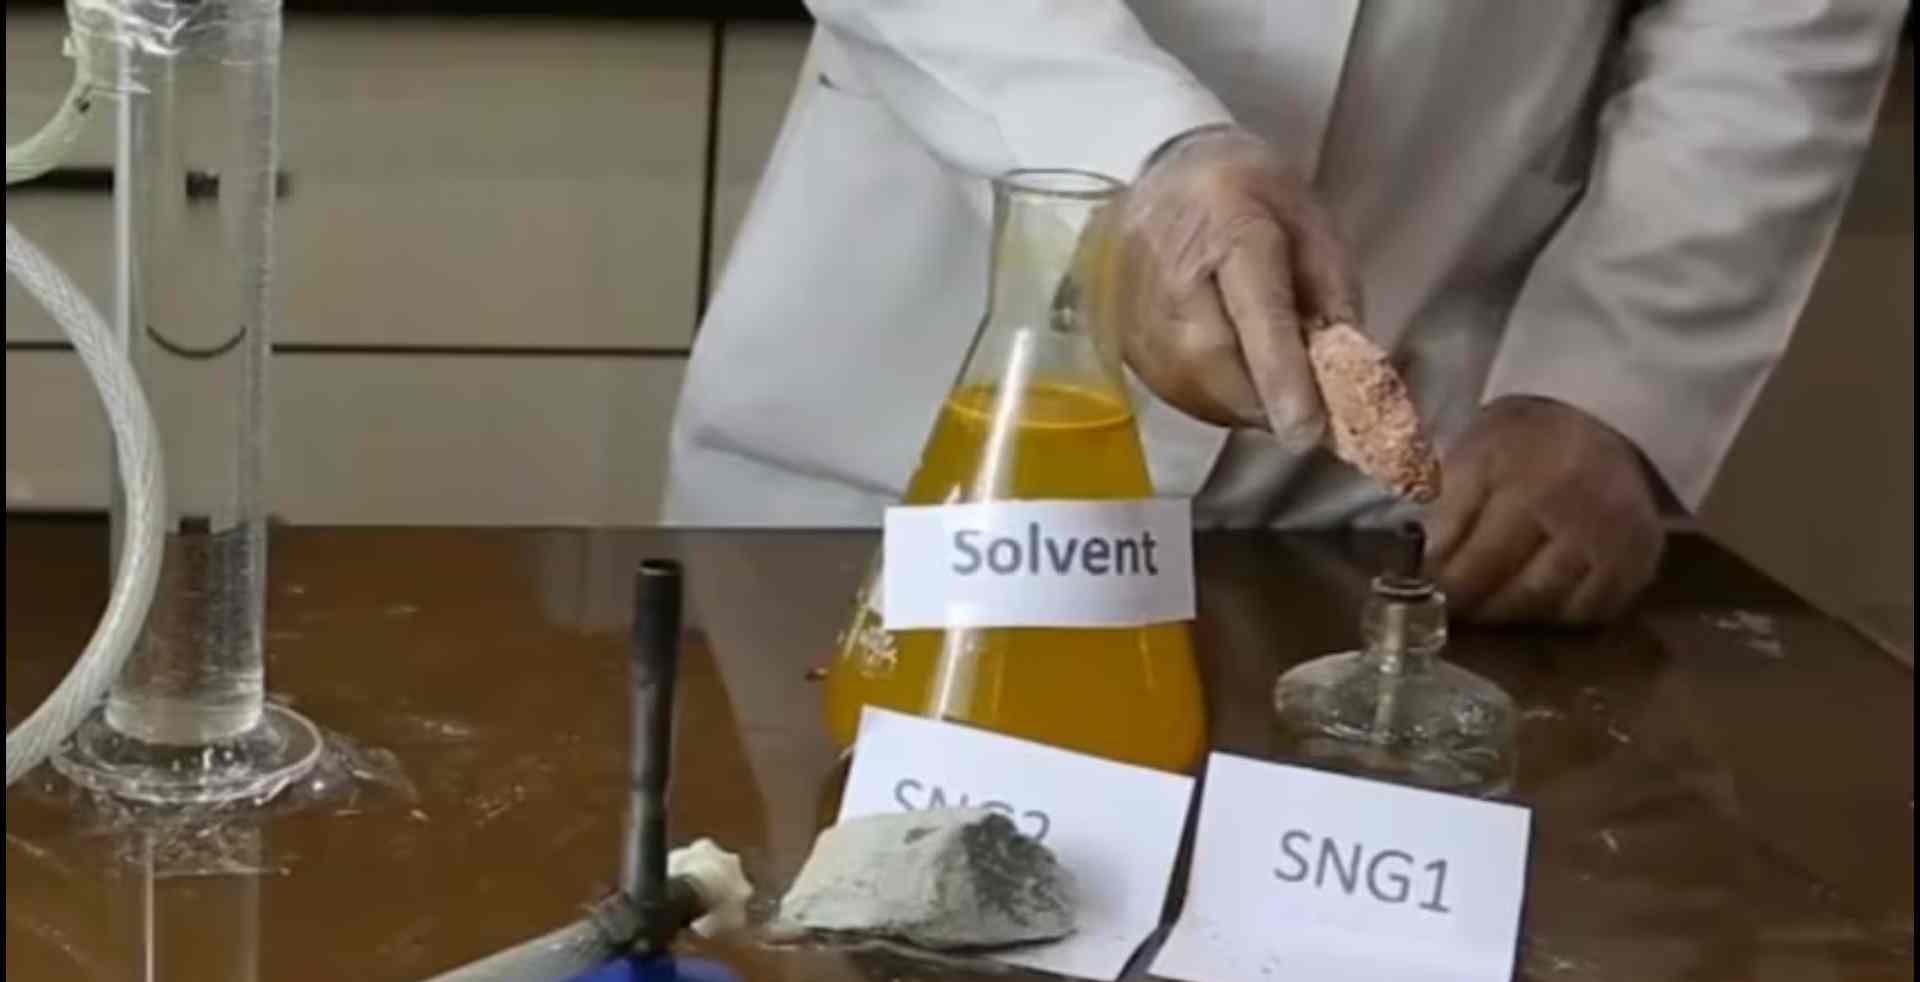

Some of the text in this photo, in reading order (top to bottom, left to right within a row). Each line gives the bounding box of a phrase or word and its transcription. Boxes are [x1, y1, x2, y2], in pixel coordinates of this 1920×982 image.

[951, 524, 1158, 577] Solvent
[894, 778, 1052, 842] S2
[1274, 829, 1453, 914] SNG1
